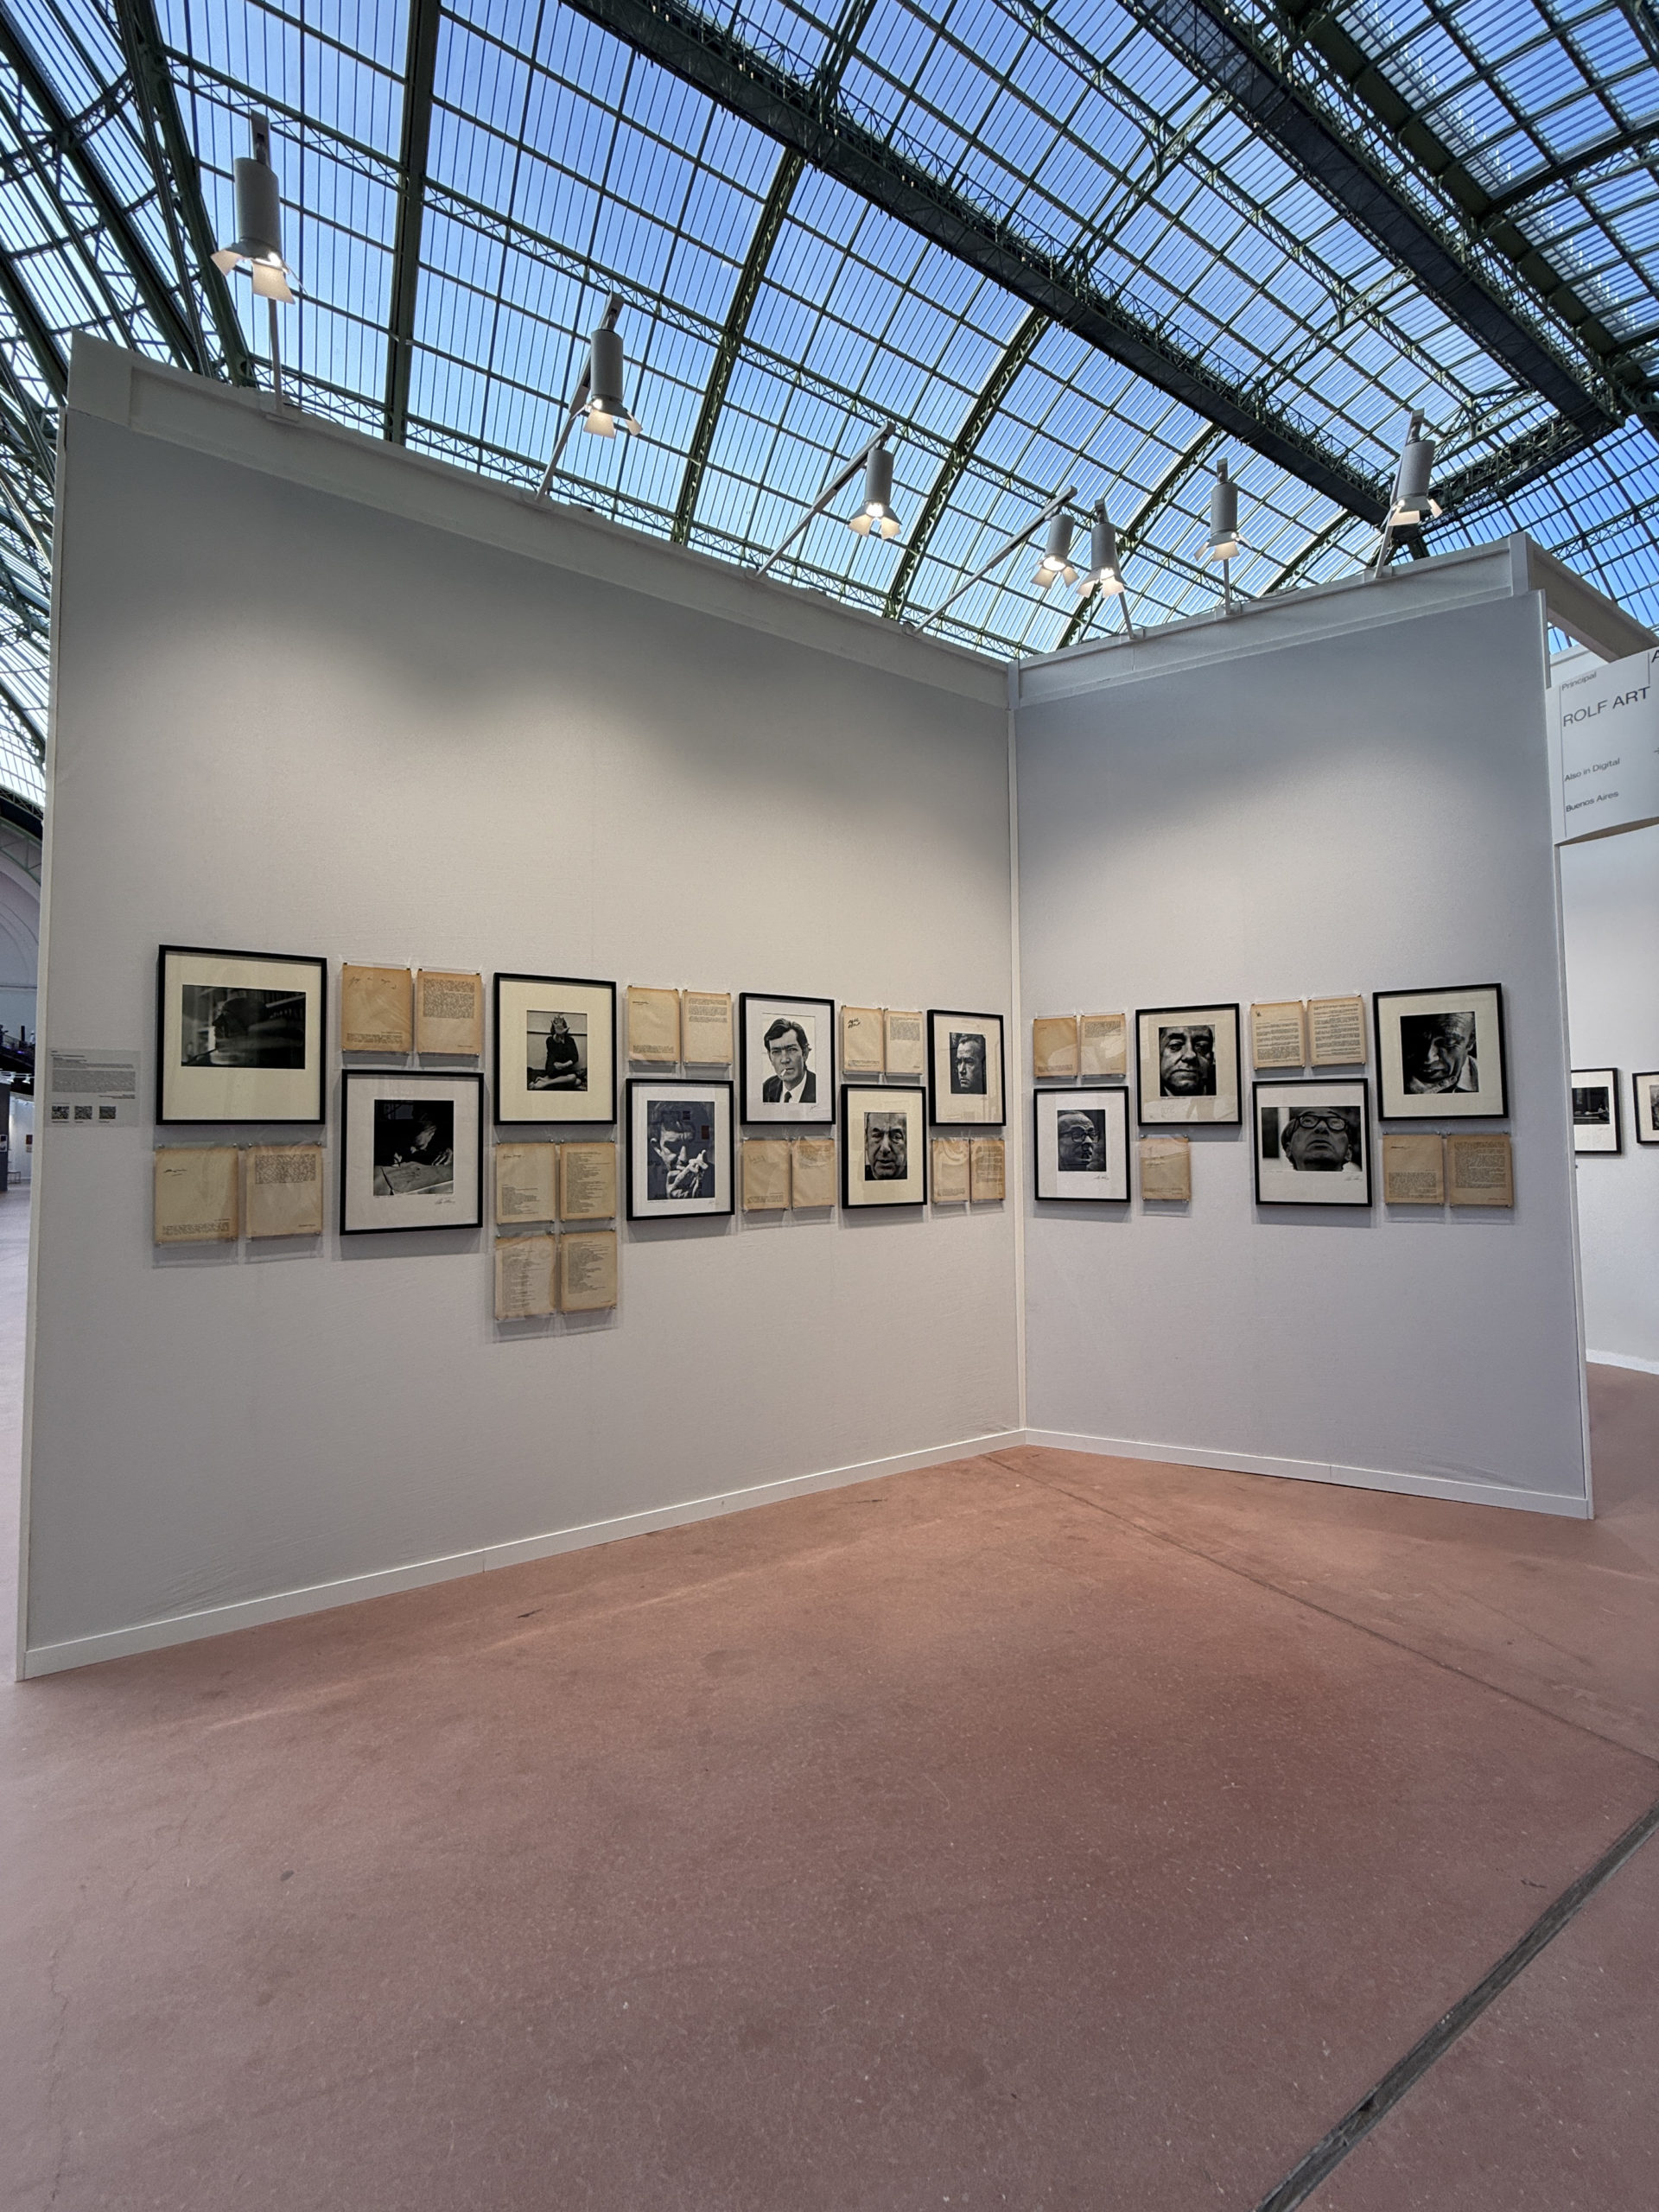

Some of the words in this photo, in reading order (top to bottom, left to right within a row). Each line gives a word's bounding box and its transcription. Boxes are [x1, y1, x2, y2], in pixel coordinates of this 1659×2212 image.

[1561, 672, 1597, 690] Principal
[1563, 700, 1608, 727] ROLF
[1612, 686, 1650, 709] ART
[1565, 770, 1582, 782] Also
[1583, 766, 1592, 776] in
[1592, 758, 1620, 772] Digital
[1566, 798, 1595, 812] Buenos
[1596, 790, 1620, 803] Aires
